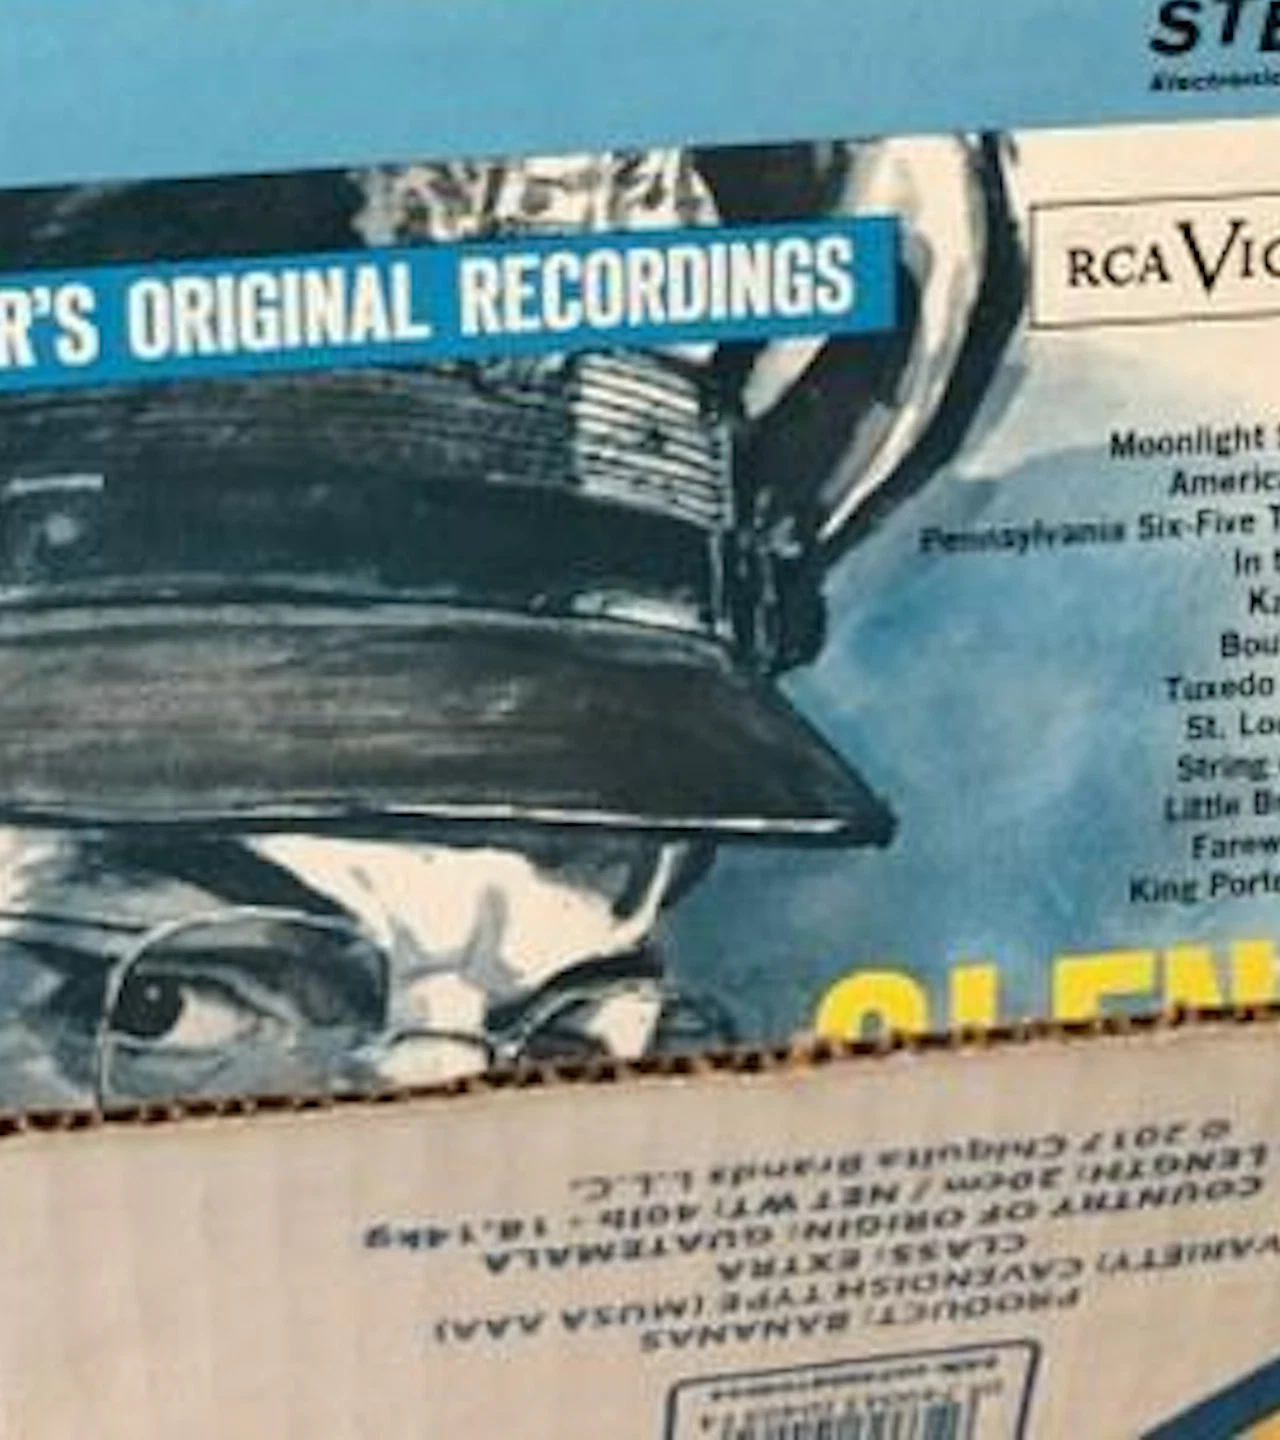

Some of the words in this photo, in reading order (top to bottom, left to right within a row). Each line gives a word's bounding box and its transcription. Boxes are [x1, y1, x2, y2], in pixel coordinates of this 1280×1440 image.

[1067, 244, 1171, 288] RCA
[126, 265, 431, 360] ORIGINAL
[460, 239, 853, 335] RECORDINGS
[1110, 422, 1265, 459] Moonlight
[921, 518, 1126, 556] Pennsylvania
[1138, 509, 1257, 542] Six-Five
[1234, 547, 1261, 577] In
[1165, 673, 1275, 702] Tuxedo
[1186, 712, 1226, 740] St.
[1176, 752, 1270, 783] String
[1164, 792, 1240, 823] Little
[1129, 873, 1198, 906] King
[878, 1133, 1068, 1172] Chiquita
[1081, 1123, 1190, 1151] 2017
[709, 1151, 863, 1188] Brands
[944, 1165, 1066, 1194] 20cm
[1076, 1145, 1269, 1185] LENGTH:
[814, 1184, 902, 1214] NET
[1051, 1175, 1265, 1220] COUNTRY
[789, 1209, 965, 1242] ORIGIN:
[978, 1204, 1039, 1228] OF
[483, 1226, 774, 1275] GUATEMALA
[874, 1233, 1028, 1264] CLASS:
[716, 1253, 861, 1284] EXTRA
[833, 1257, 1084, 1300] CAVENDISH
[561, 1295, 705, 1332] (MUSA
[721, 1287, 820, 1315] TYPE
[863, 1287, 1081, 1327] PRODUCT:
[433, 1313, 545, 1345] AAA)
[640, 1312, 852, 1352] BANANAS
